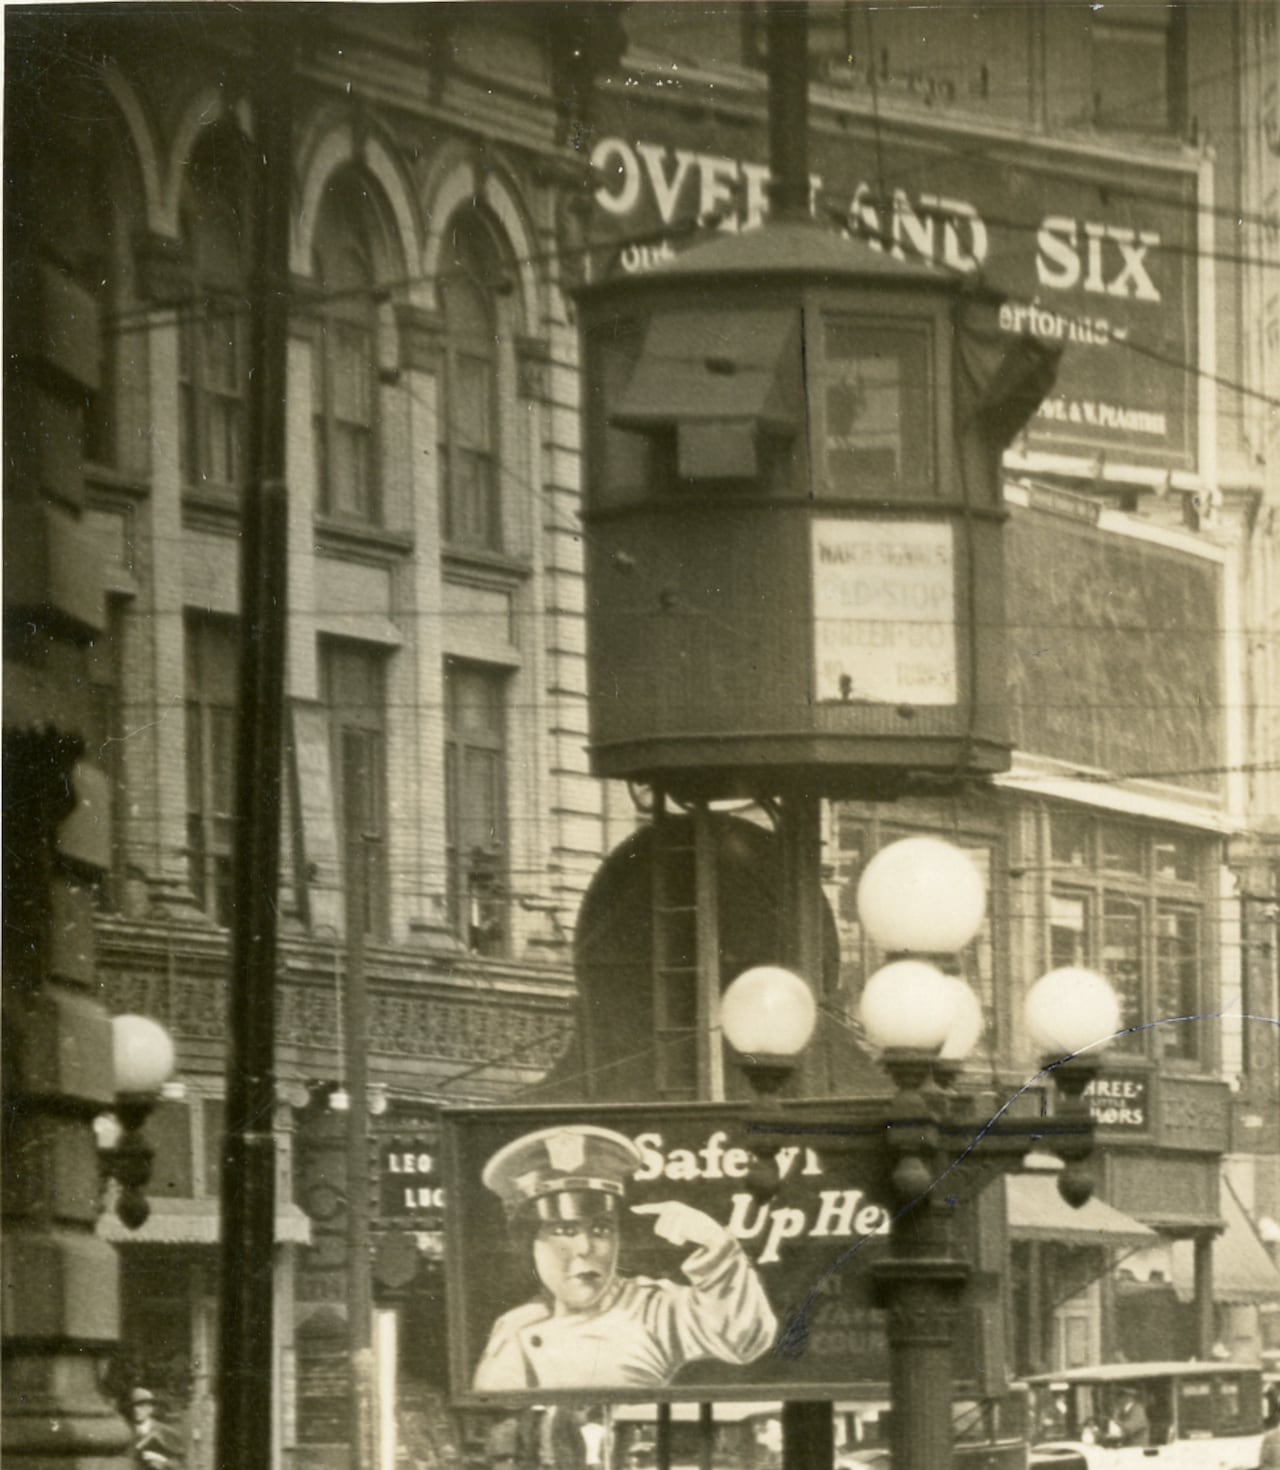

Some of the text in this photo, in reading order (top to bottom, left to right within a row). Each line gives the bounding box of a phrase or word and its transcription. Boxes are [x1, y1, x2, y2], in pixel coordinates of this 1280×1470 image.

[1035, 214, 1161, 302] SIX
[1083, 1079, 1137, 1098] HREE
[728, 1192, 806, 1264] Up
